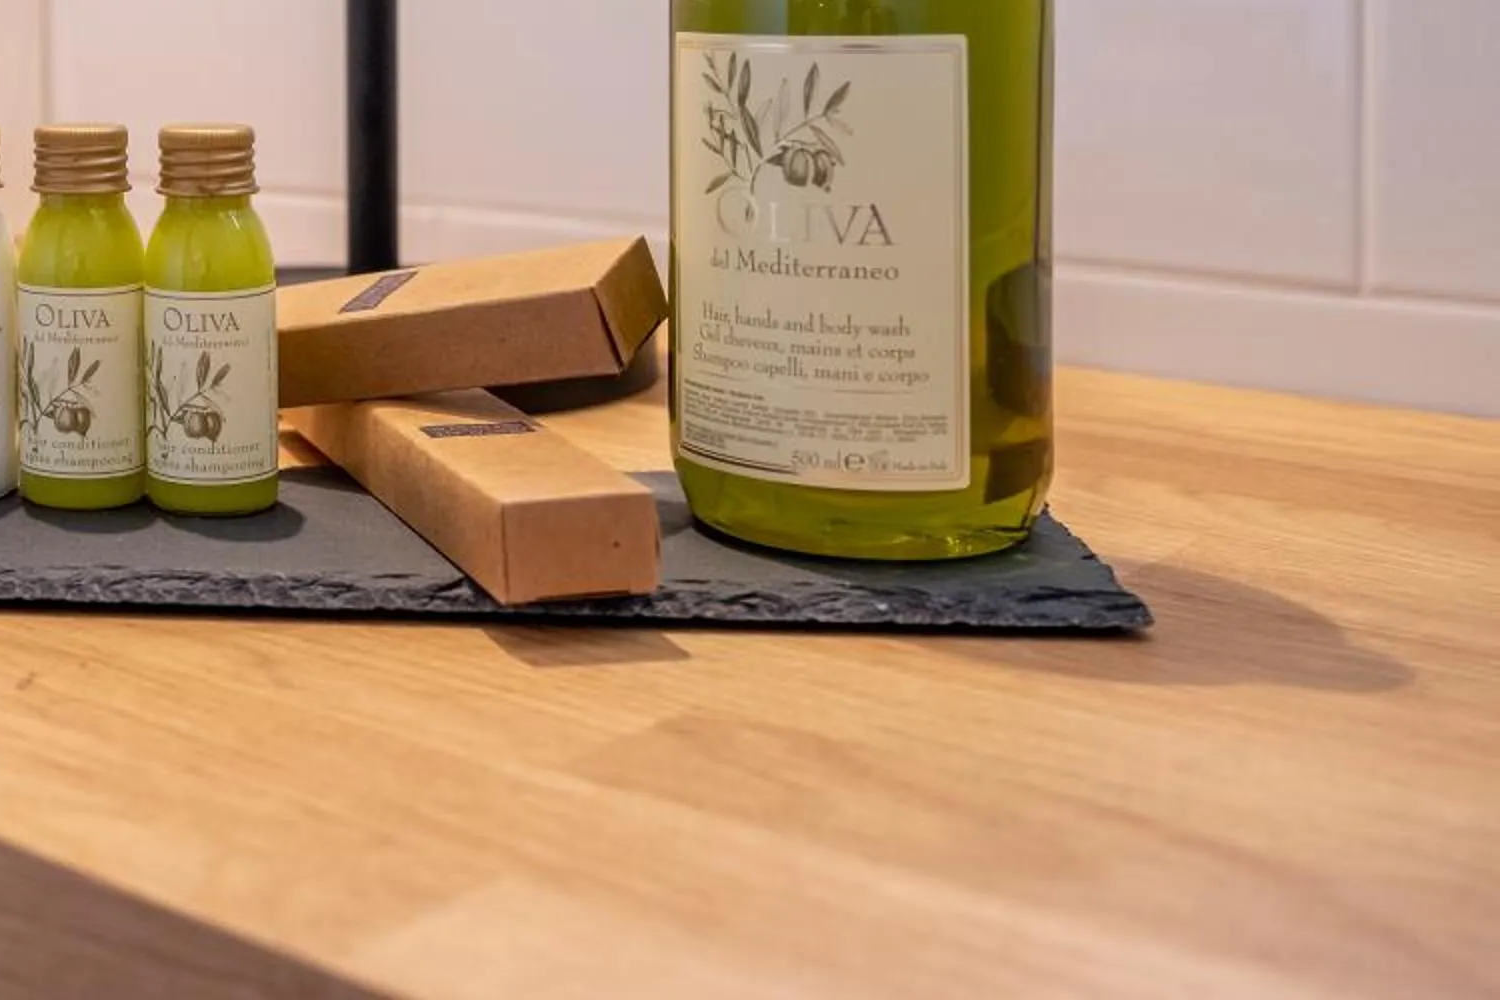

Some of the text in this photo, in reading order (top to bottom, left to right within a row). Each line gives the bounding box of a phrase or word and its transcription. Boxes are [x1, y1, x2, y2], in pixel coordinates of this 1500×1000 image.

[736, 247, 900, 281] Mediterraneo
[35, 303, 111, 329] OLIVA
[163, 307, 241, 332] OLIVA
[735, 305, 779, 330] hands
[783, 312, 815, 333] and
[818, 313, 863, 340] body
[867, 314, 911, 337] wash
[693, 342, 930, 386] Shampoo capelli, mani e corpo
[790, 339, 842, 357] mains
[847, 344, 862, 358] et
[867, 346, 916, 363] corps
[791, 450, 819, 469] 500
[824, 448, 841, 469] ml
